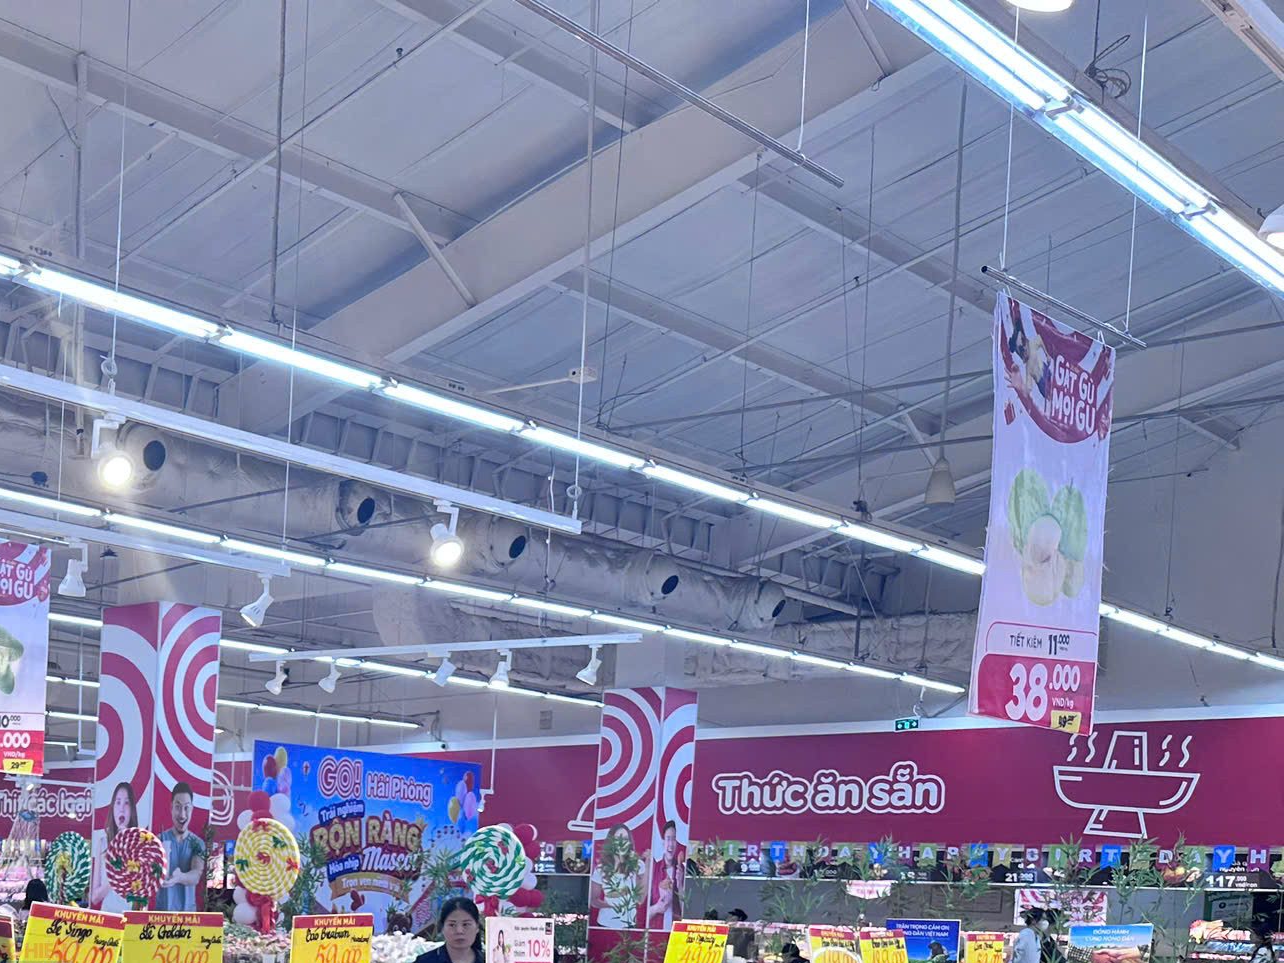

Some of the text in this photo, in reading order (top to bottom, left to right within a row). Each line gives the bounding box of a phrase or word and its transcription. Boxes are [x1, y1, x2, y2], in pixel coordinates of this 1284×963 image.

[1055, 355, 1095, 404] GẬT GÙ
[1052, 388, 1096, 435] MỌI GU
[16, 563, 33, 583] GÙ
[14, 580, 34, 600] GU
[1009, 632, 1025, 648] TIẾT
[318, 756, 432, 808] GO! Hải Phòng
[715, 766, 941, 811] Thức ăn sẵn
[54, 908, 89, 923] KHUYẾN
[148, 912, 184, 923] KHUYẾN
[314, 916, 342, 926] KHUYẾN
[157, 923, 192, 940] Golden
[527, 939, 551, 958] 10%
